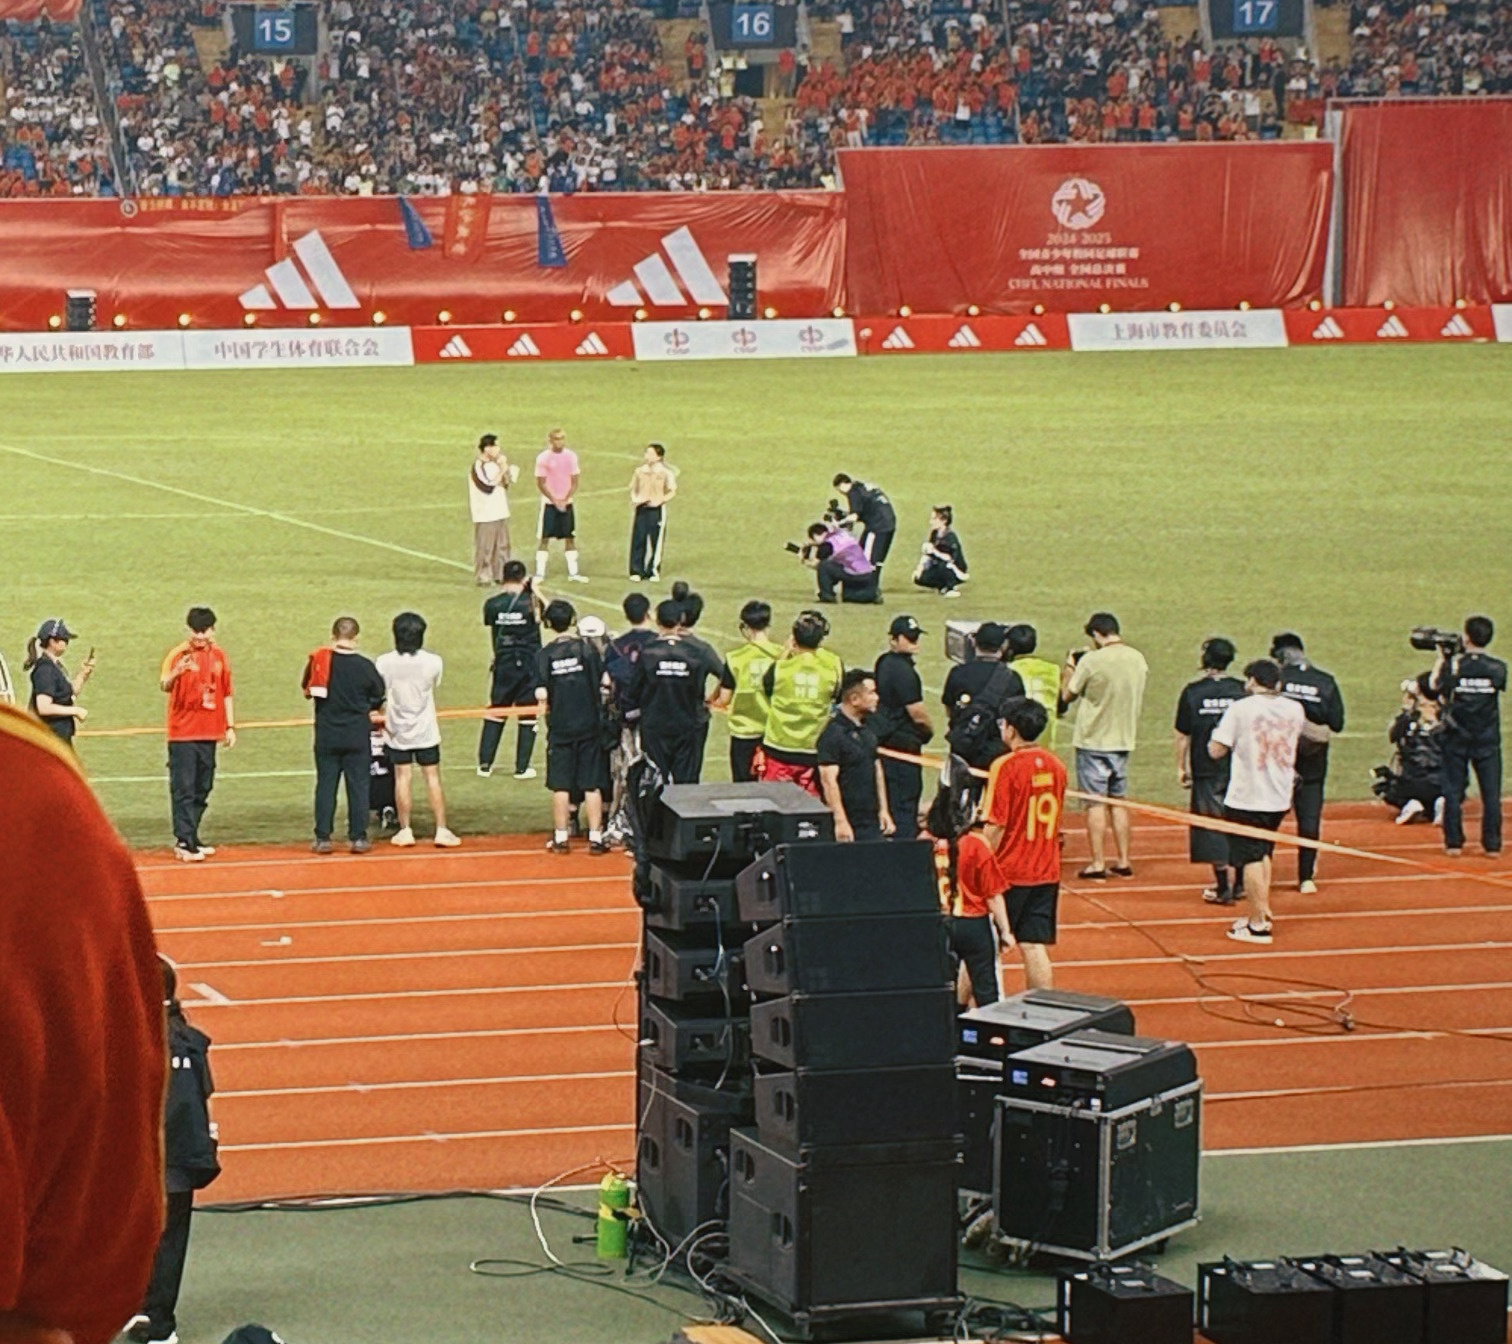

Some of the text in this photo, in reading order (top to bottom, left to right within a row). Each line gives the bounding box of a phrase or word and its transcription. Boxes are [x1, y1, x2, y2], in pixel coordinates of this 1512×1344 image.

[736, 12, 770, 36] 16
[1238, 0, 1274, 25] 17
[258, 18, 292, 42] 15
[1026, 791, 1059, 842] 19
